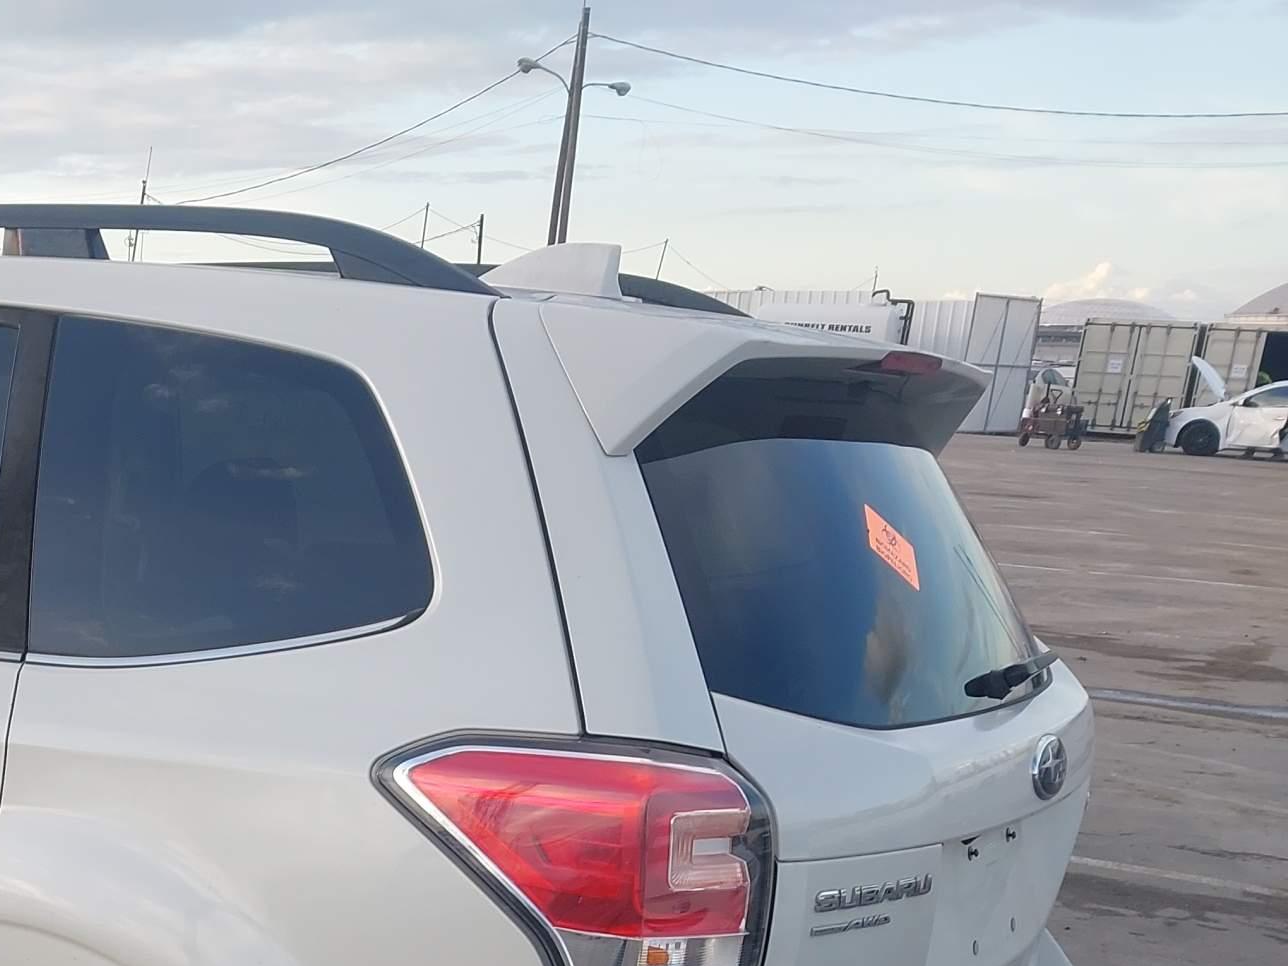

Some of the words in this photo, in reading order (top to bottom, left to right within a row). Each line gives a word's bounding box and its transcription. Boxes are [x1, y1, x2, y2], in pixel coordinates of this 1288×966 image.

[828, 323, 872, 334] RENTALS
[814, 873, 933, 913] SUBARU
[844, 913, 891, 933] AWD
